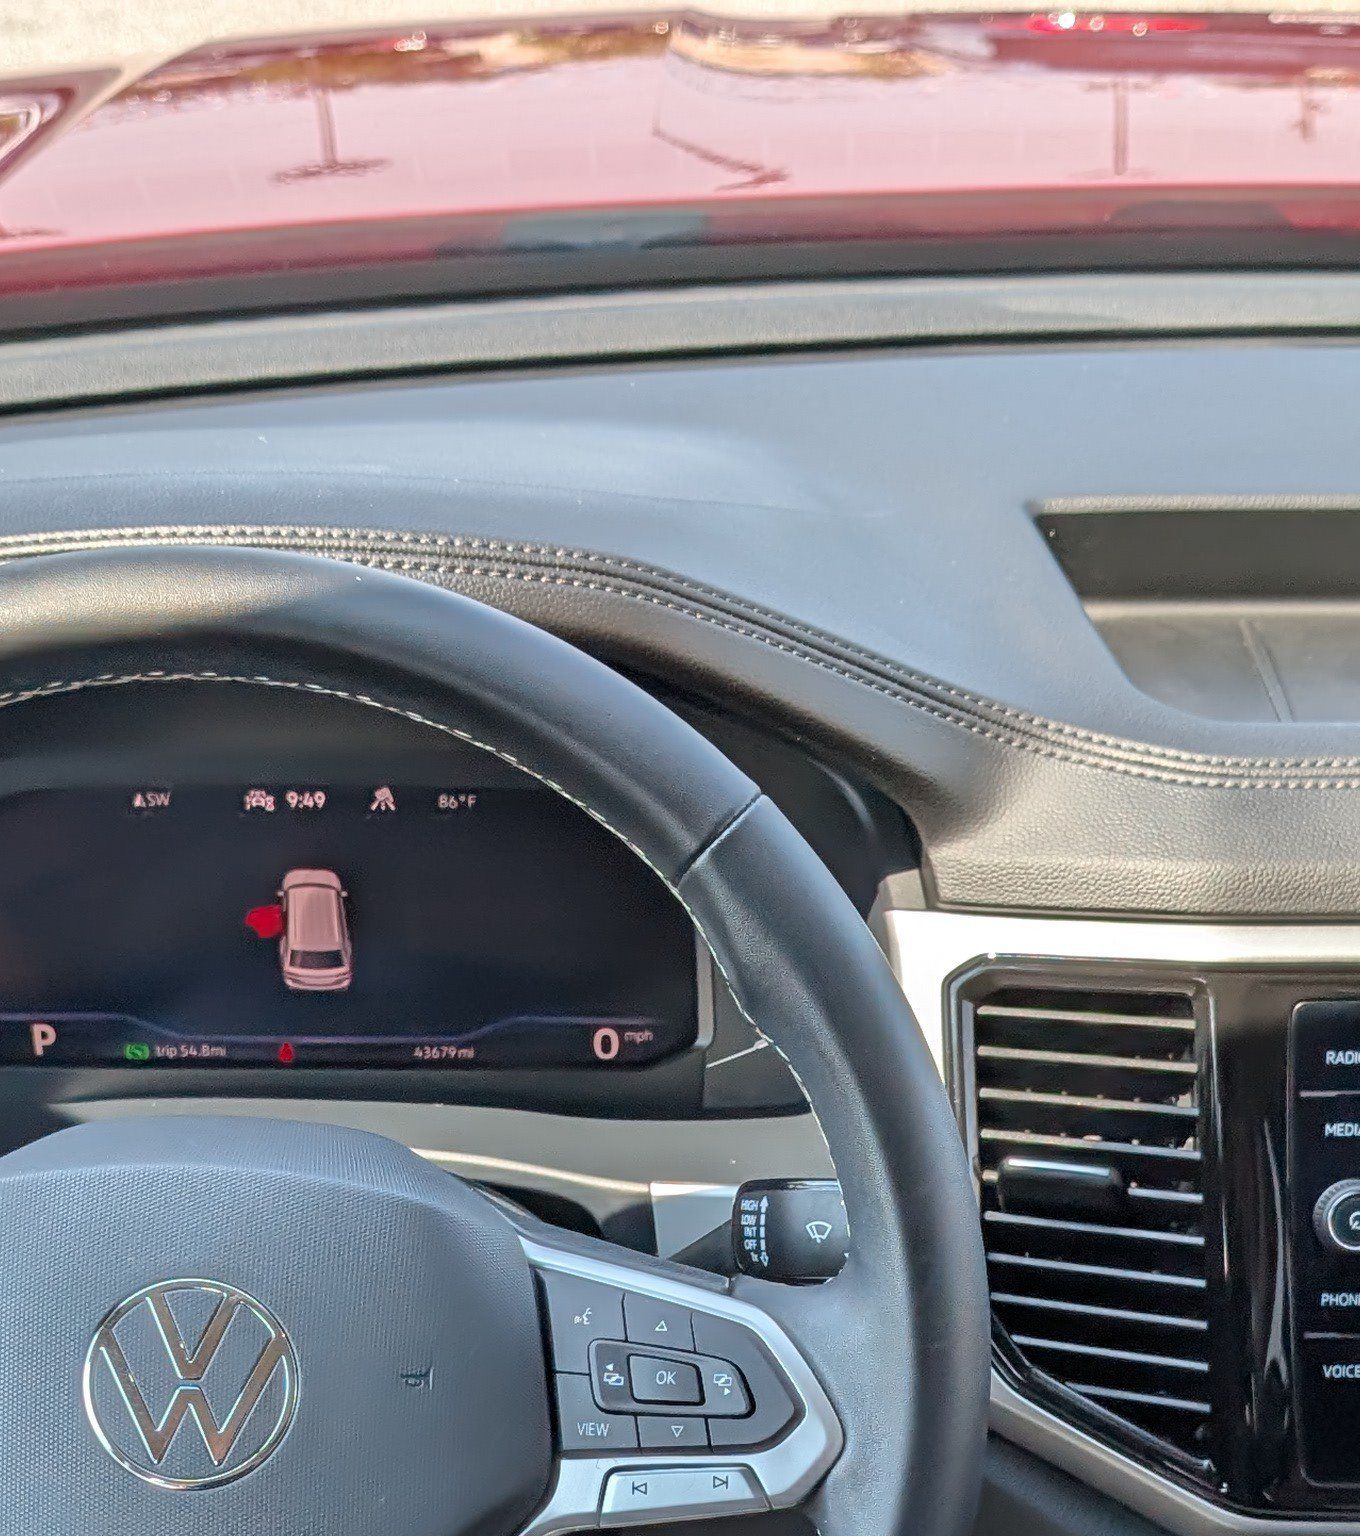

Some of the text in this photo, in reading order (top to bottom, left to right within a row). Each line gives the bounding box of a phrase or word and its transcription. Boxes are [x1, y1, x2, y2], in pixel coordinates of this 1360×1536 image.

[285, 790, 327, 808] 9:49
[31, 1023, 57, 1056] P
[744, 1239, 758, 1251] OFF
[655, 1370, 678, 1386] OK
[576, 1422, 610, 1438] VIEW
